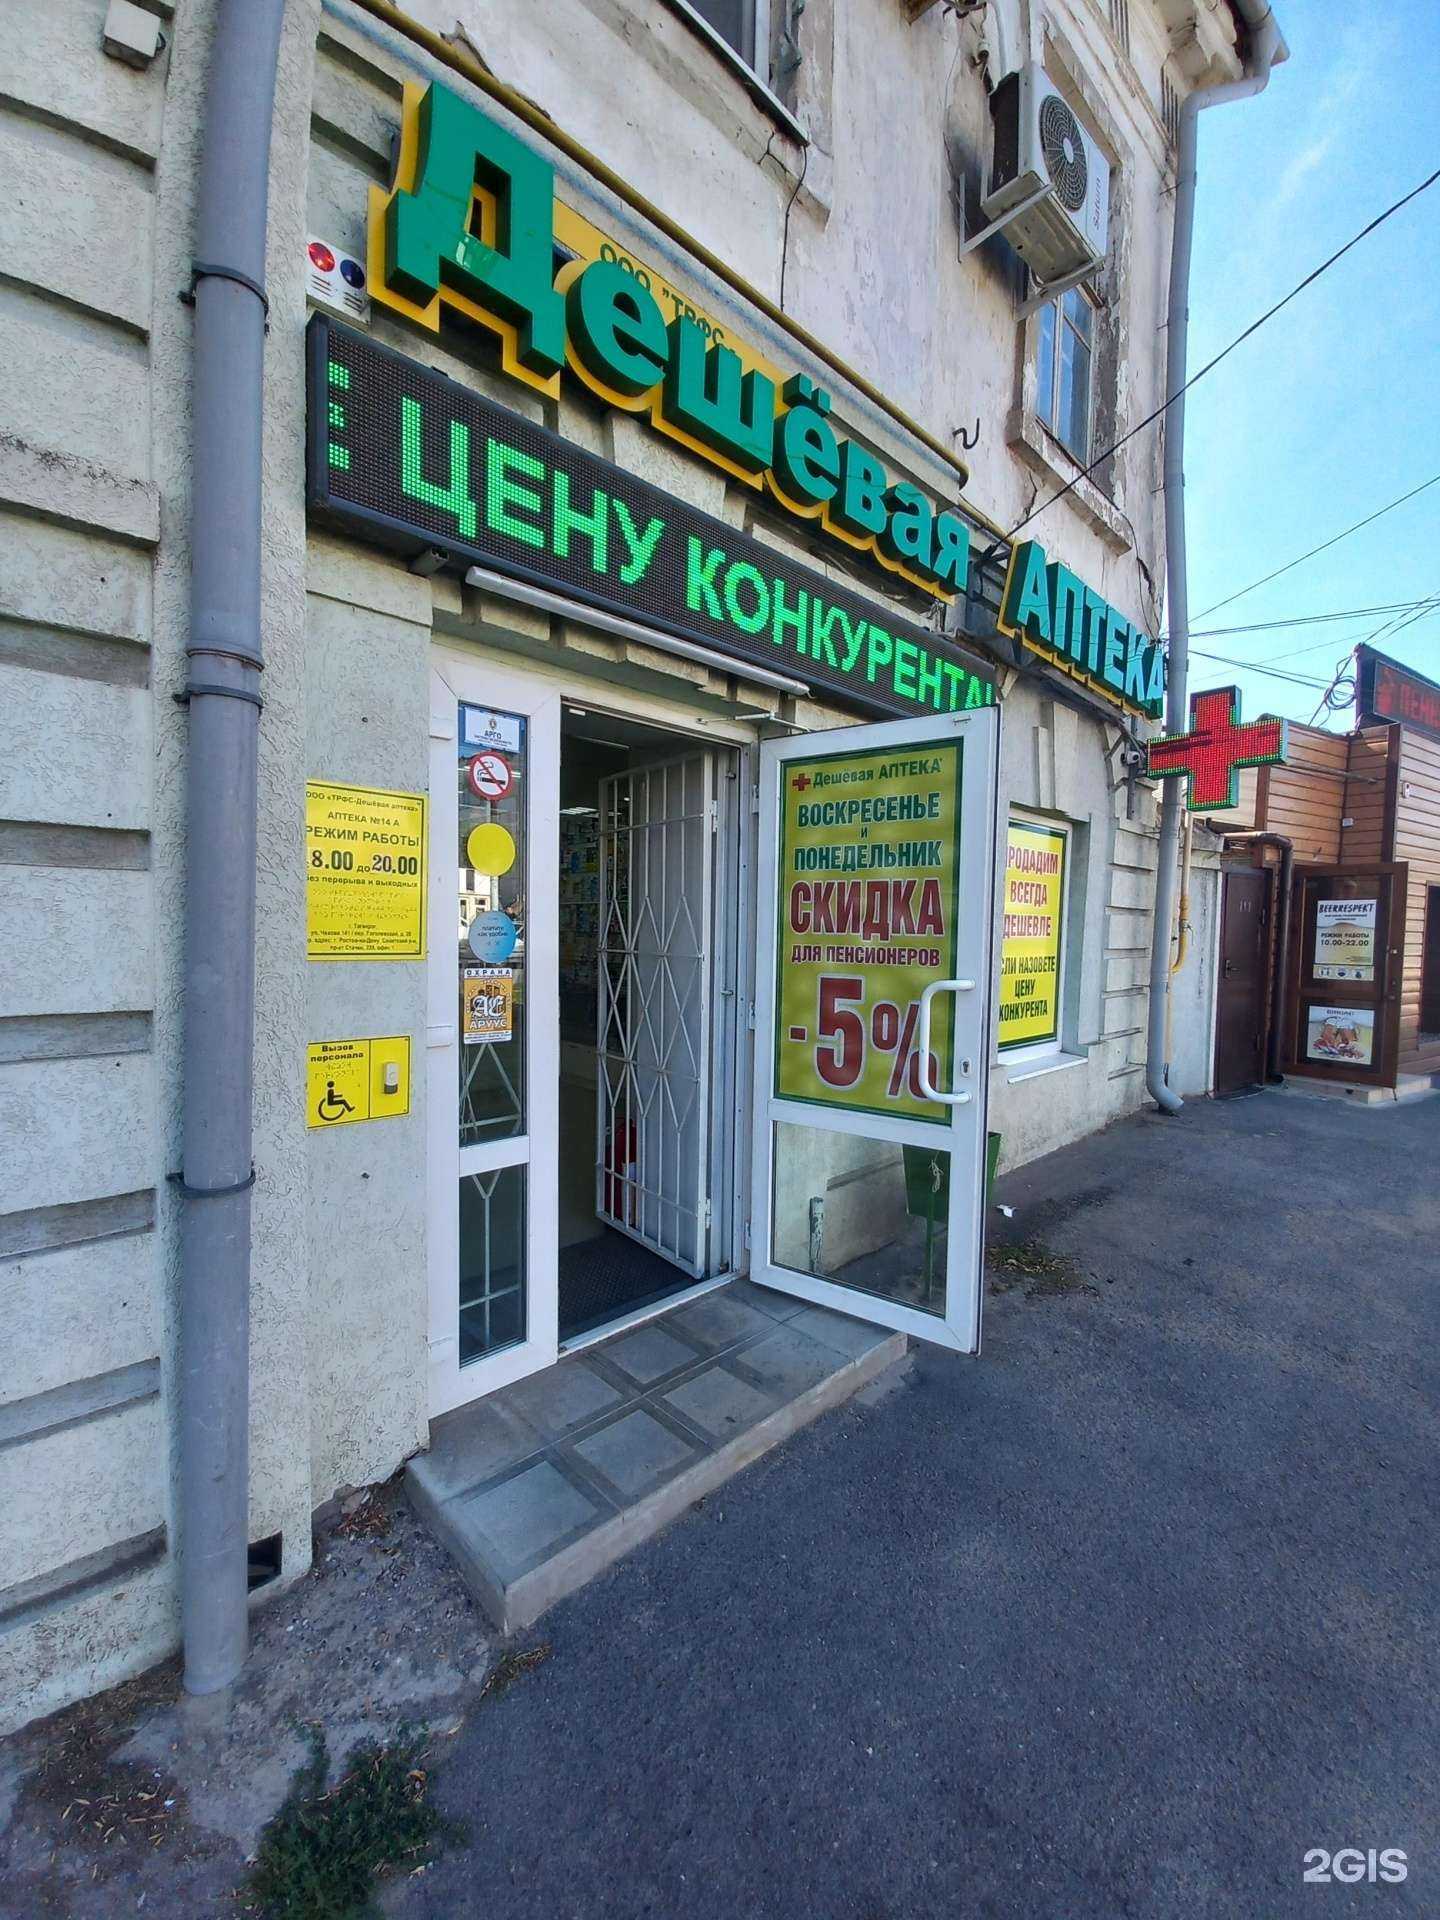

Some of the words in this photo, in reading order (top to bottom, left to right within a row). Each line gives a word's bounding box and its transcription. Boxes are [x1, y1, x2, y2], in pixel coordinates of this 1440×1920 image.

[385, 80, 971, 592] Дешёвая
[1006, 540, 1164, 717] АПТЕКА
[402, 395, 666, 585] ЦЕНУ
[328, 811, 367, 823] АПТЕКА
[798, 793, 940, 827] ВОСКРЕСЕНЬЕ
[363, 831, 420, 848] РАБОТЫ
[312, 850, 353, 871] 8.00
[356, 865, 370, 873] до
[372, 854, 417, 875] 20.00
[795, 841, 942, 871] ПОНЕДЕЛЬНИК
[1006, 846, 1059, 875] РОДАДИМ
[321, 876, 365, 885] перерыва
[376, 880, 417, 888] выходных
[1010, 880, 1048, 907] ВСЕГДА
[791, 879, 944, 940] СКИДКА
[1319, 903, 1374, 914] BEERRESPEKT
[1003, 914, 1051, 938] ДЕШЕВЛЕ
[1320, 939, 1369, 947] 10.00-22.00
[792, 945, 821, 963] ДЛЯ
[827, 945, 941, 967] ПЕНСИОНЕРОВ
[1019, 955, 1056, 974] НАЗОВЕТЕ
[1014, 978, 1036, 999] ЦЕНУ
[999, 1000, 1048, 1022] КОНКУРЕНТА
[310, 1051, 364, 1063] персонала
[321, 1044, 354, 1052] Вызов
